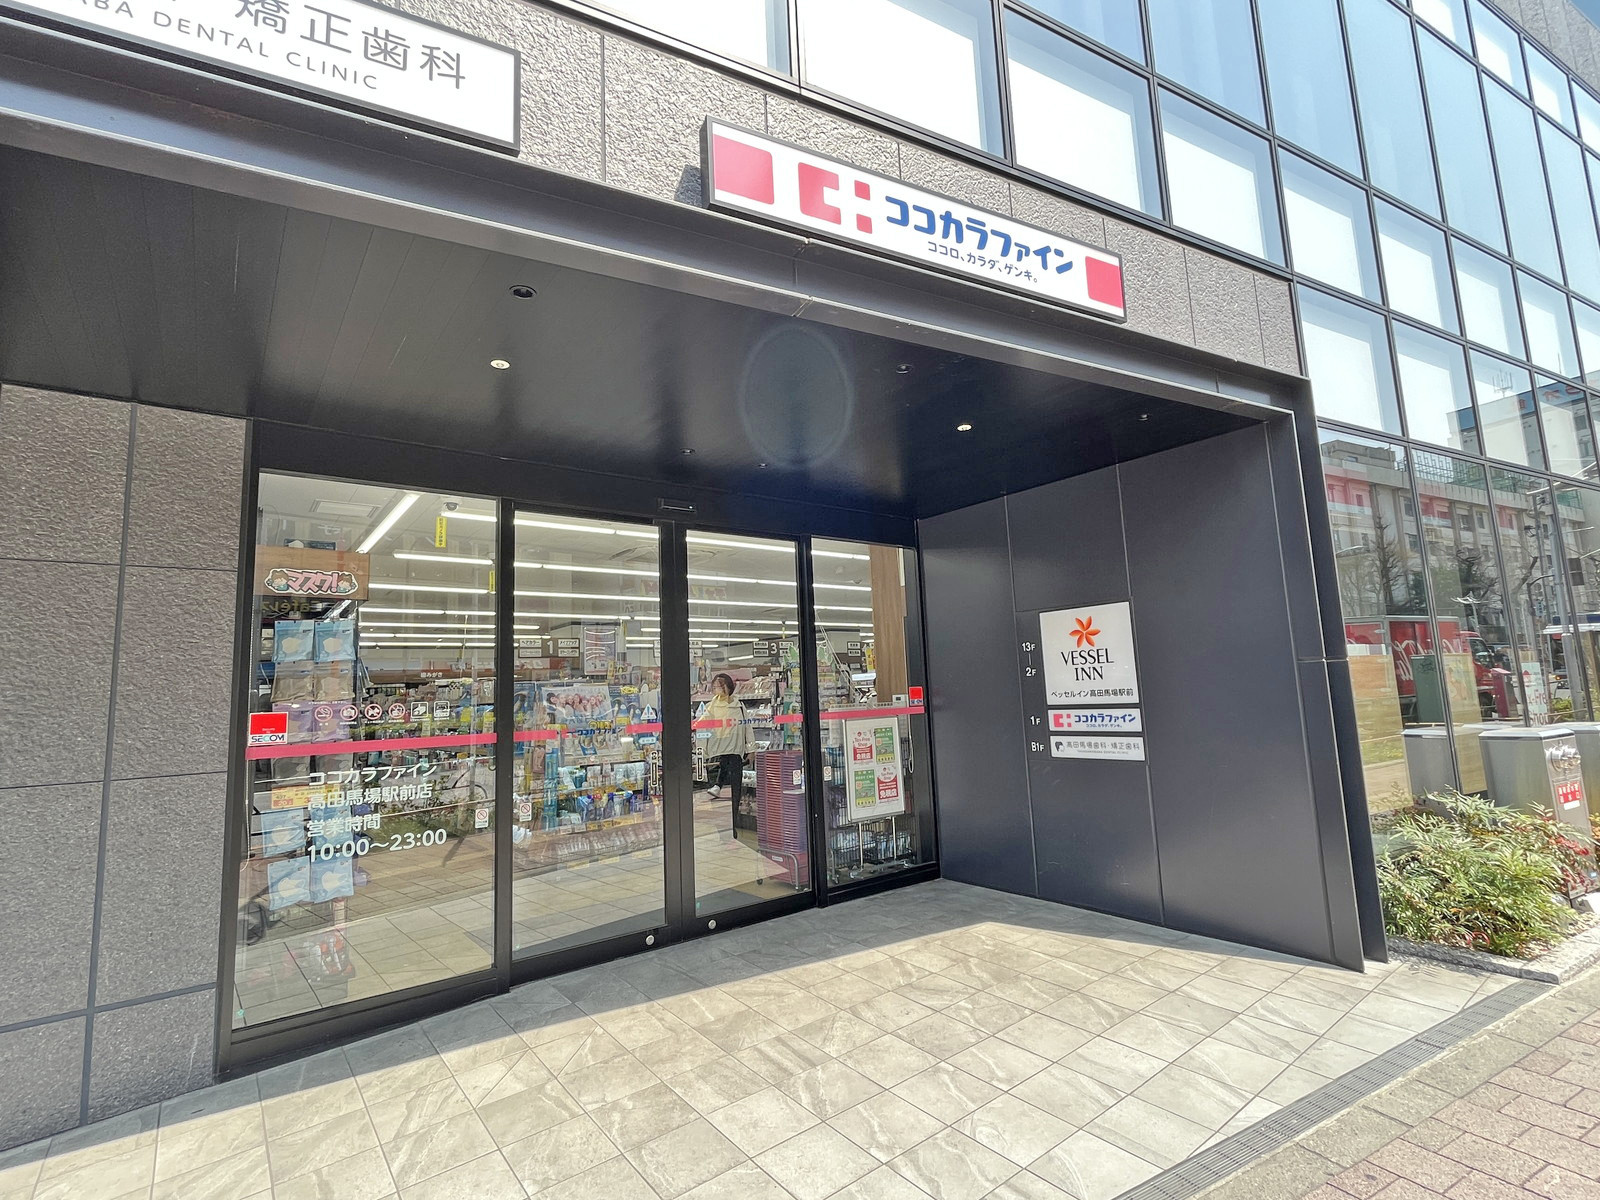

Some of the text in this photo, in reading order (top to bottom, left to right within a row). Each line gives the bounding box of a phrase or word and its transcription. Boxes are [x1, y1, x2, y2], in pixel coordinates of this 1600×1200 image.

[153, 11, 270, 58] DENTAL
[286, 51, 378, 90] CLINIC
[885, 195, 1073, 275] ココカラファイン
[1022, 642, 1036, 651] 13F
[1061, 648, 1114, 665] VESSEL
[1026, 668, 1037, 676] 2F
[1075, 666, 1104, 681] INN
[1030, 716, 1041, 725] 1F
[1074, 713, 1136, 723] ココカラファイン
[251, 734, 286, 743] SECOM
[1031, 742, 1045, 752] B1F
[309, 763, 437, 786] ココカラファイン
[307, 783, 433, 811] 高田馬場駅前店
[307, 813, 381, 839] 営業時間
